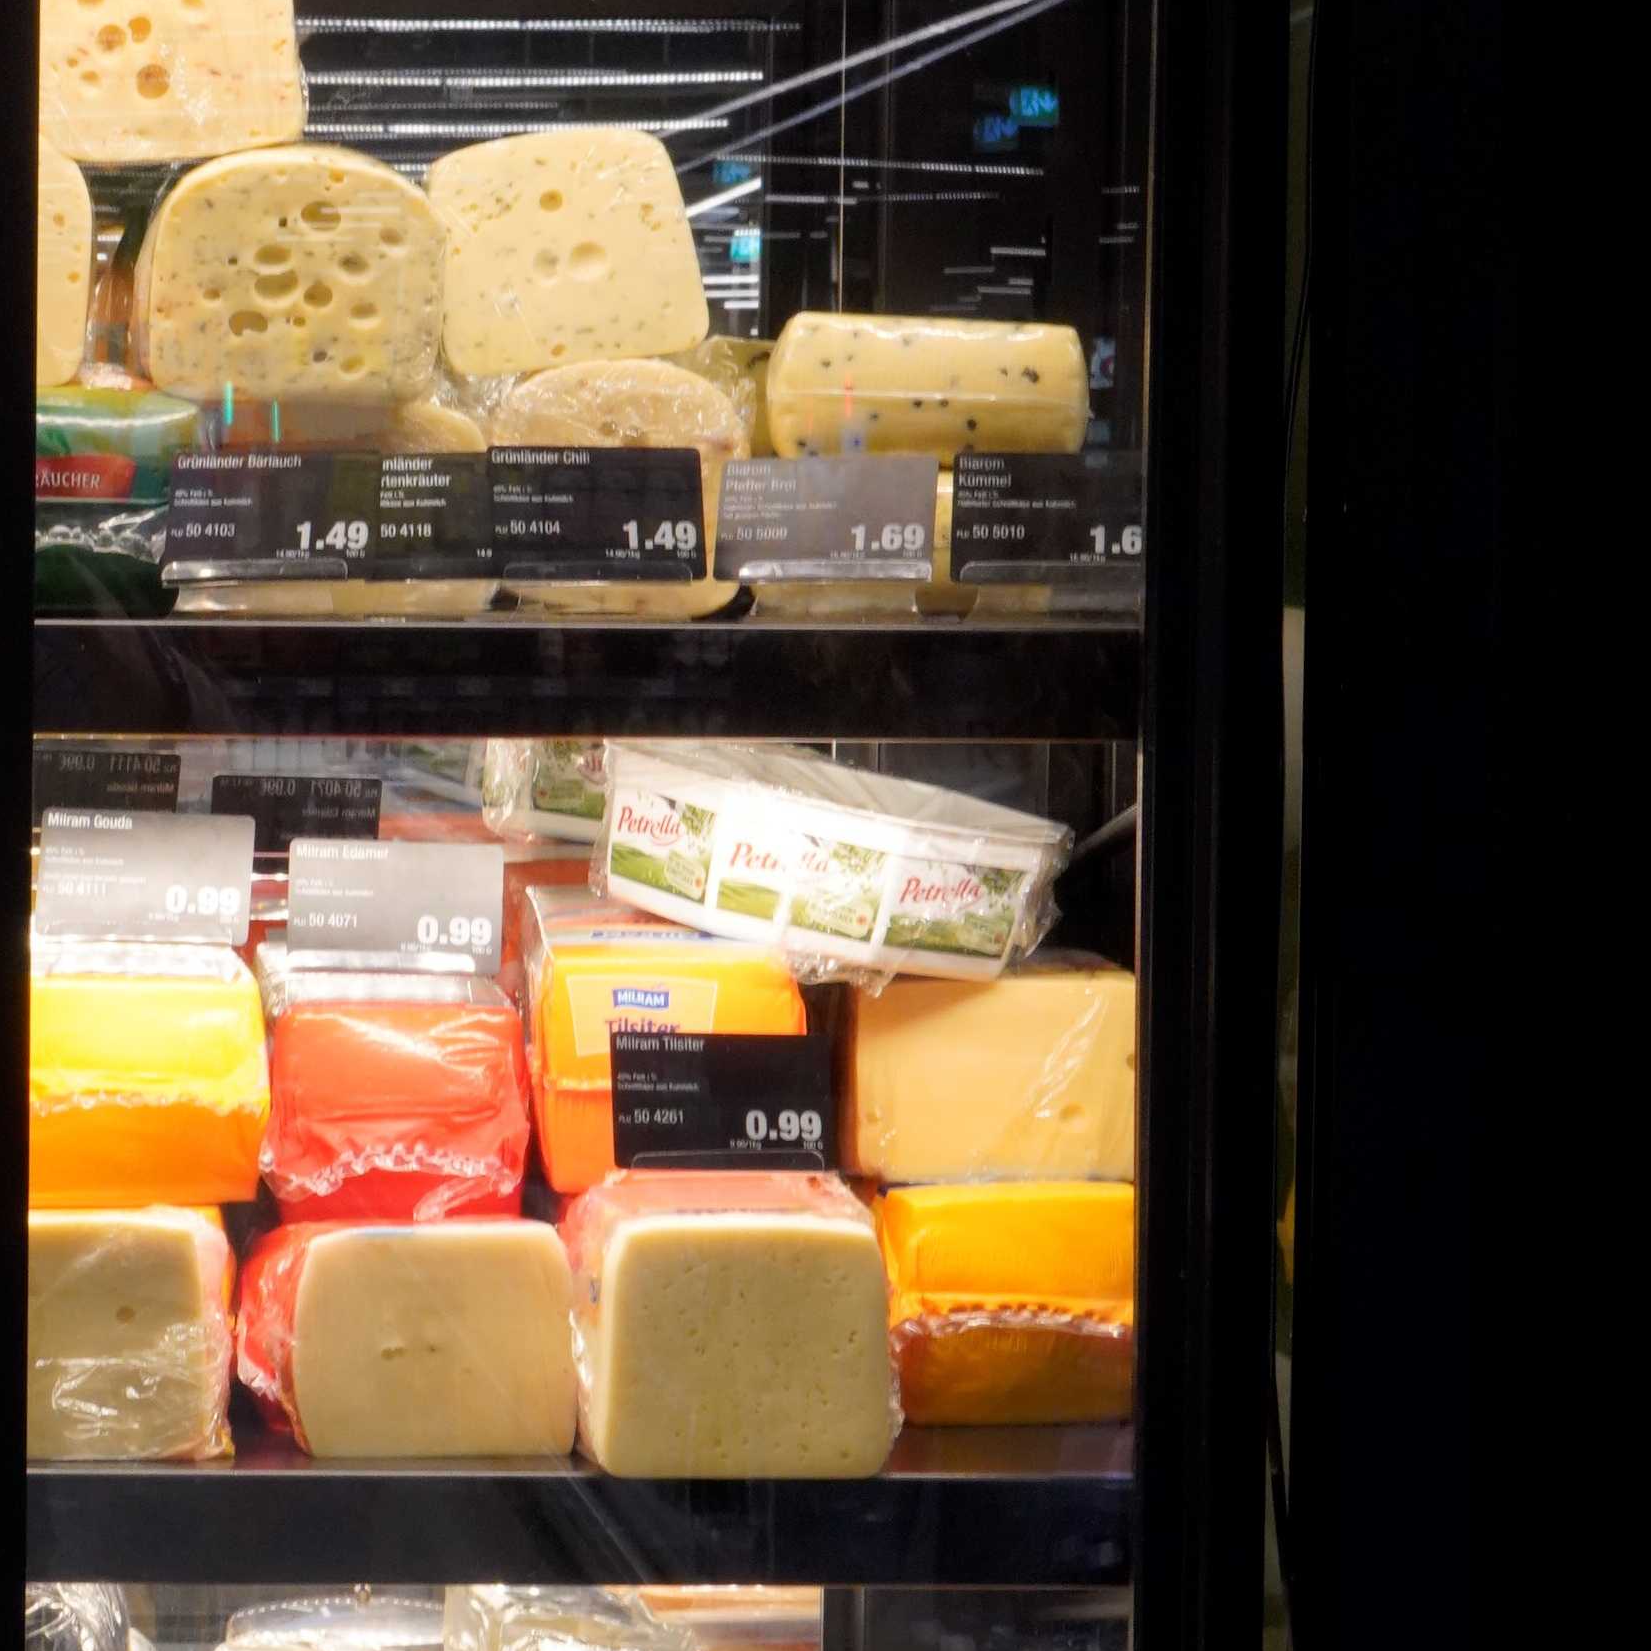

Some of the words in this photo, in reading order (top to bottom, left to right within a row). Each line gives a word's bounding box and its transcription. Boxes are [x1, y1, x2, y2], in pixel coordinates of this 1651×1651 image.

[178, 455, 243, 469] Grünländer
[248, 453, 301, 469] Bärlauch
[492, 450, 560, 465] Grünländer
[563, 451, 590, 464] Chili
[959, 457, 1004, 470] Biarom
[958, 474, 1011, 487] Kümmel
[186, 524, 201, 537] 50
[205, 523, 235, 537] 4103
[510, 520, 526, 534] 50
[530, 520, 560, 534] 4104
[737, 527, 752, 540] 50
[973, 525, 989, 539] 50
[992, 525, 1025, 539] 5010
[297, 521, 368, 550] 1.49
[623, 520, 697, 550] 1.49
[851, 523, 925, 551] 1.69
[48, 813, 90, 829] Milram
[94, 815, 133, 829] Gouda
[617, 806, 684, 846] Petrella
[297, 845, 339, 859] Milram
[343, 845, 389, 860] Edamer
[166, 884, 241, 915] 0.99
[899, 876, 982, 911] Petrella
[309, 913, 324, 927] 50
[328, 913, 358, 928] 4071
[417, 915, 492, 946] 0.99
[617, 990, 665, 1007] MILRAM
[605, 1018, 680, 1033] Tilsiter
[616, 1038, 659, 1050] Milram
[663, 1038, 705, 1051] Tilsiter
[635, 1109, 649, 1123] 50
[653, 1109, 684, 1124] 4261
[746, 1110, 822, 1141] 0.99
